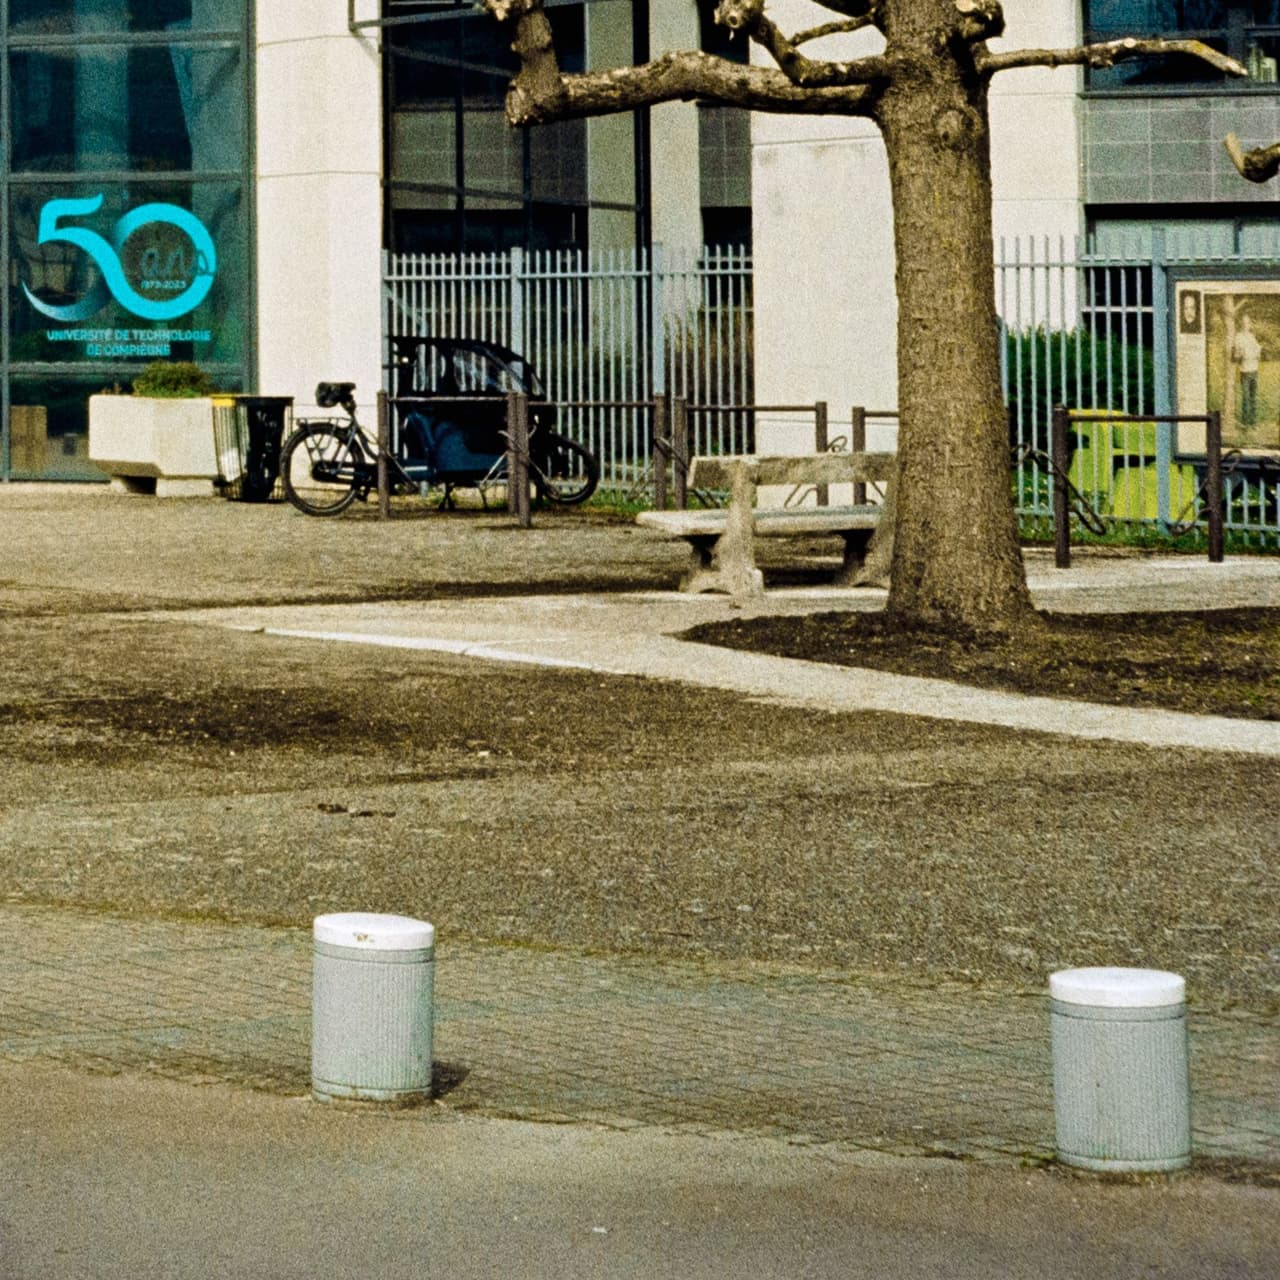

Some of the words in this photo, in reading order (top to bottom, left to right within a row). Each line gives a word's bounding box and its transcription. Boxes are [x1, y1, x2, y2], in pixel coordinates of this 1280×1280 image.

[21, 192, 216, 321] 50
[114, 329, 129, 341] DE
[133, 329, 211, 341] TECHNOLOGIE
[87, 344, 101, 356] DE
